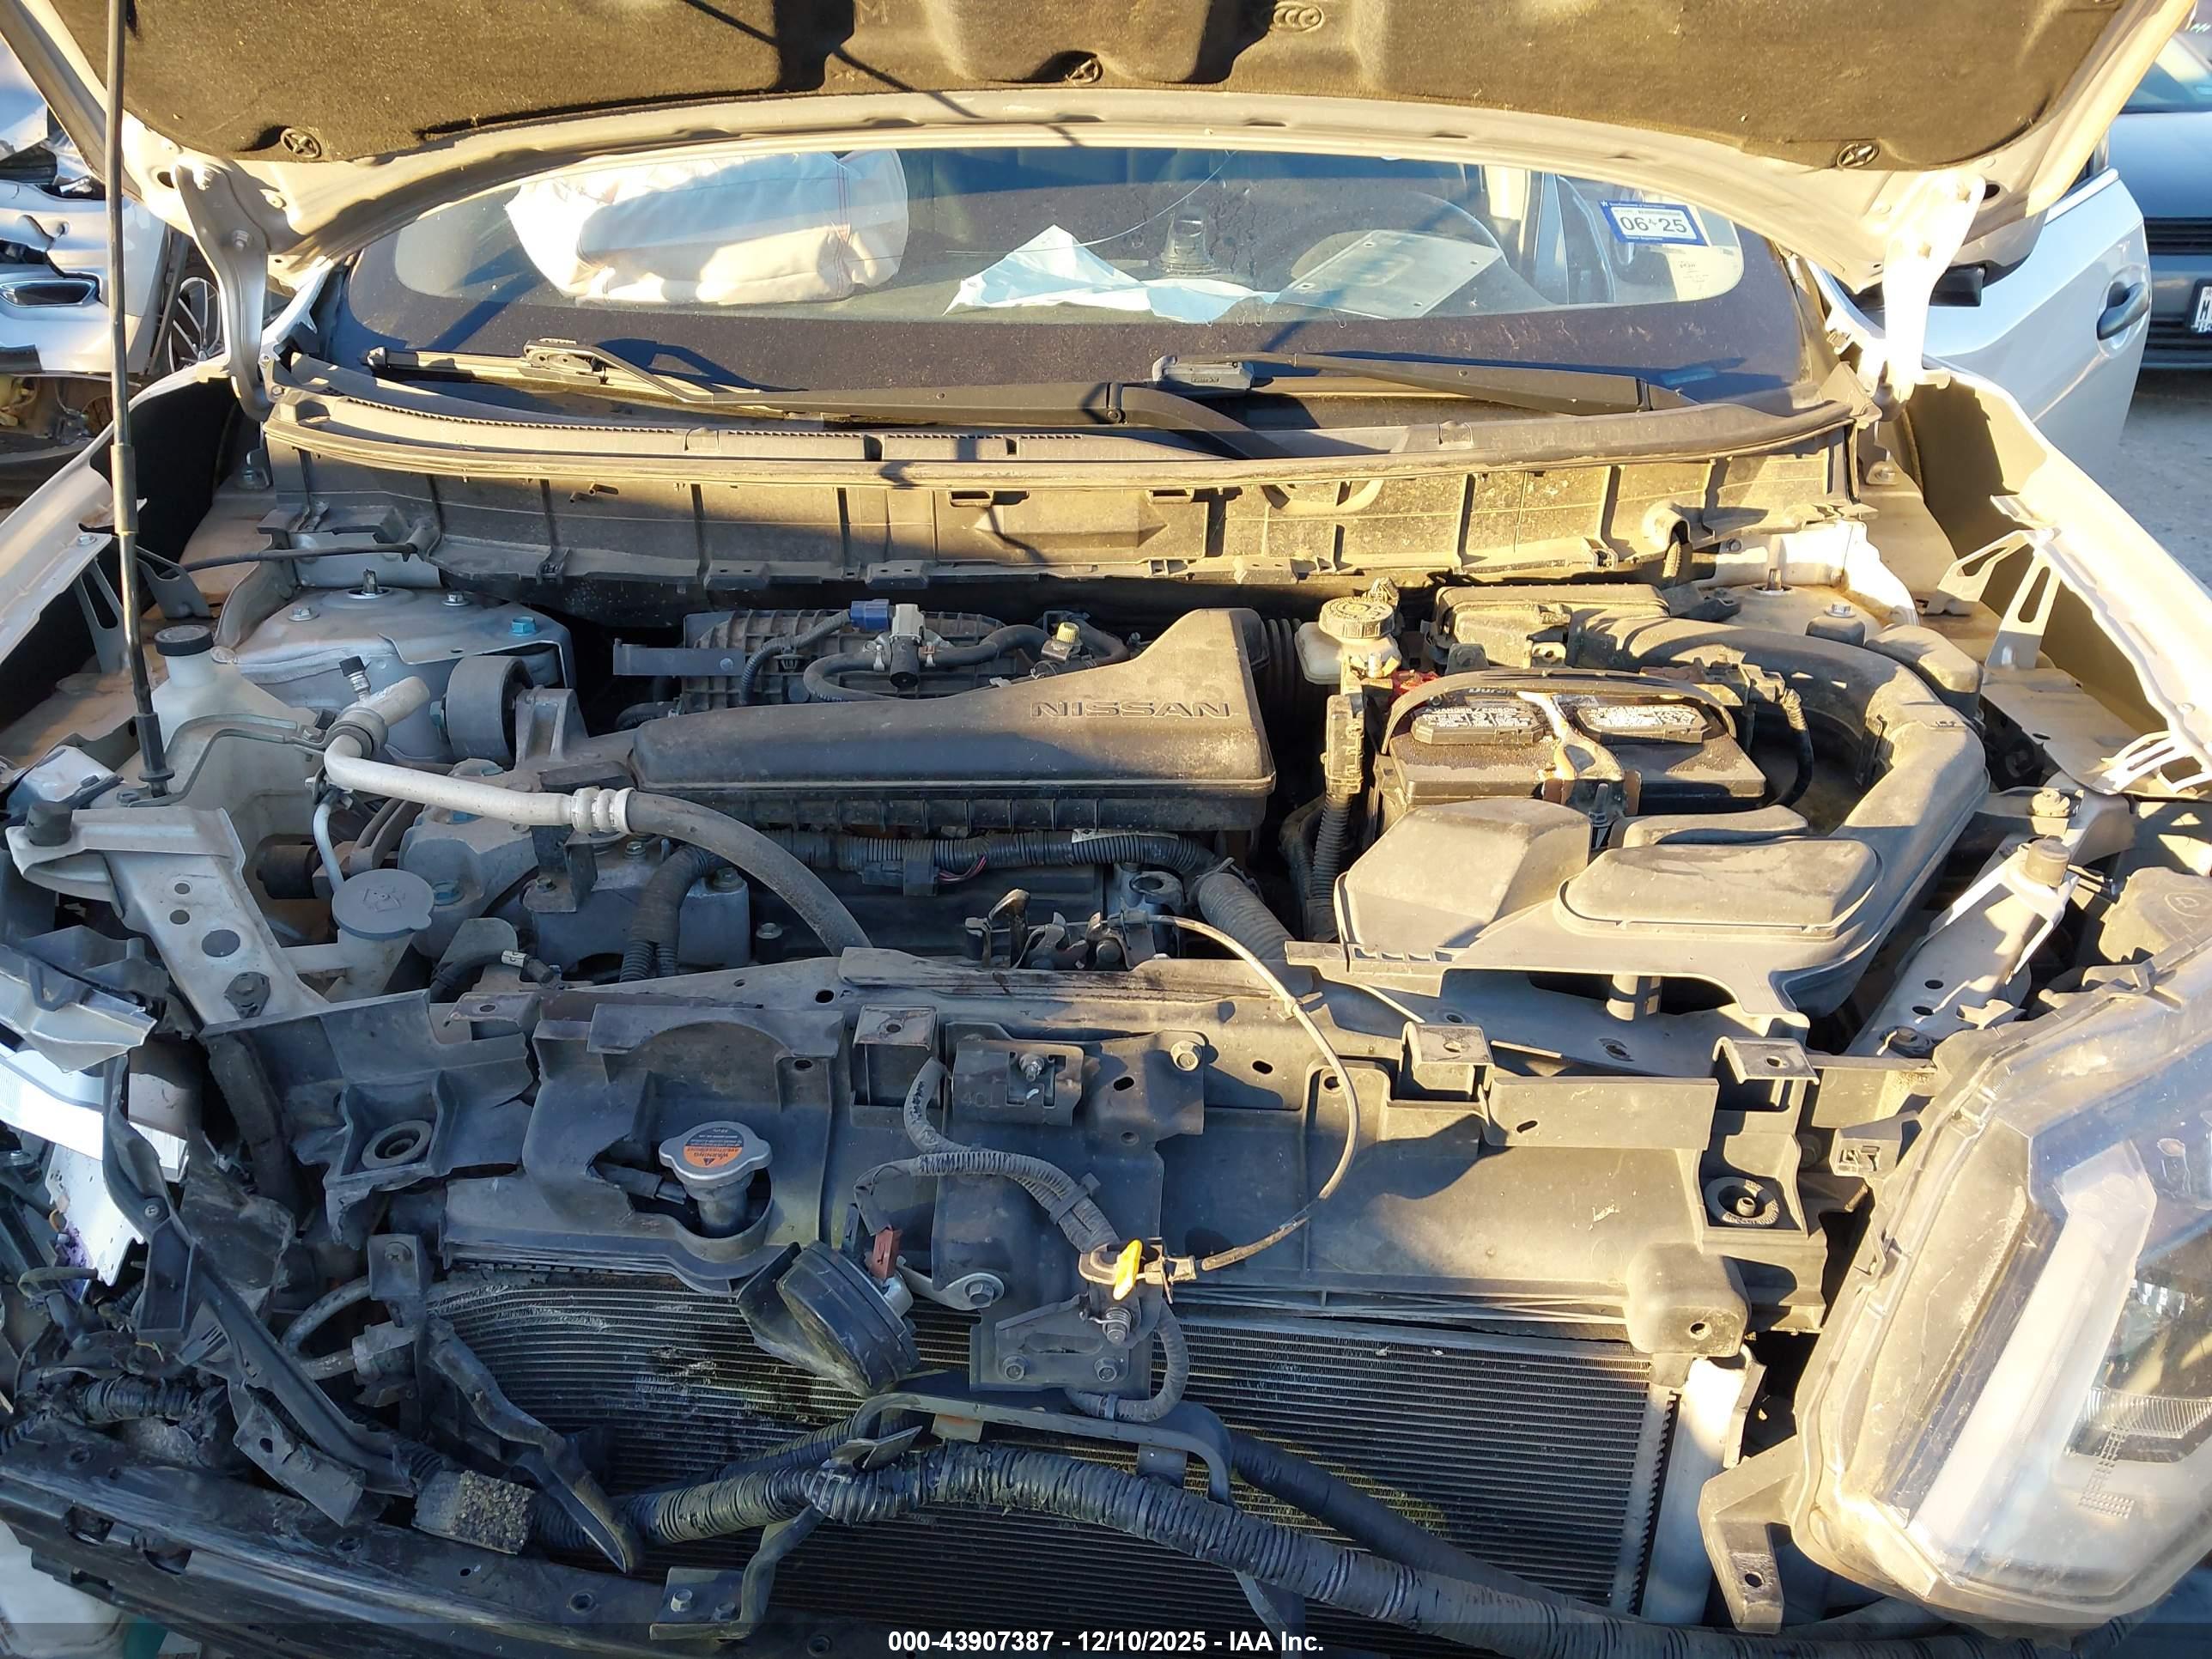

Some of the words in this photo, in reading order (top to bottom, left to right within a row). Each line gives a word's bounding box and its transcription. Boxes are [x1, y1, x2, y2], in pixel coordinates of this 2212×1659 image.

[1620, 216, 1650, 232] 06
[1658, 218, 1688, 234] 25
[1031, 701, 1231, 719] NISSAN
